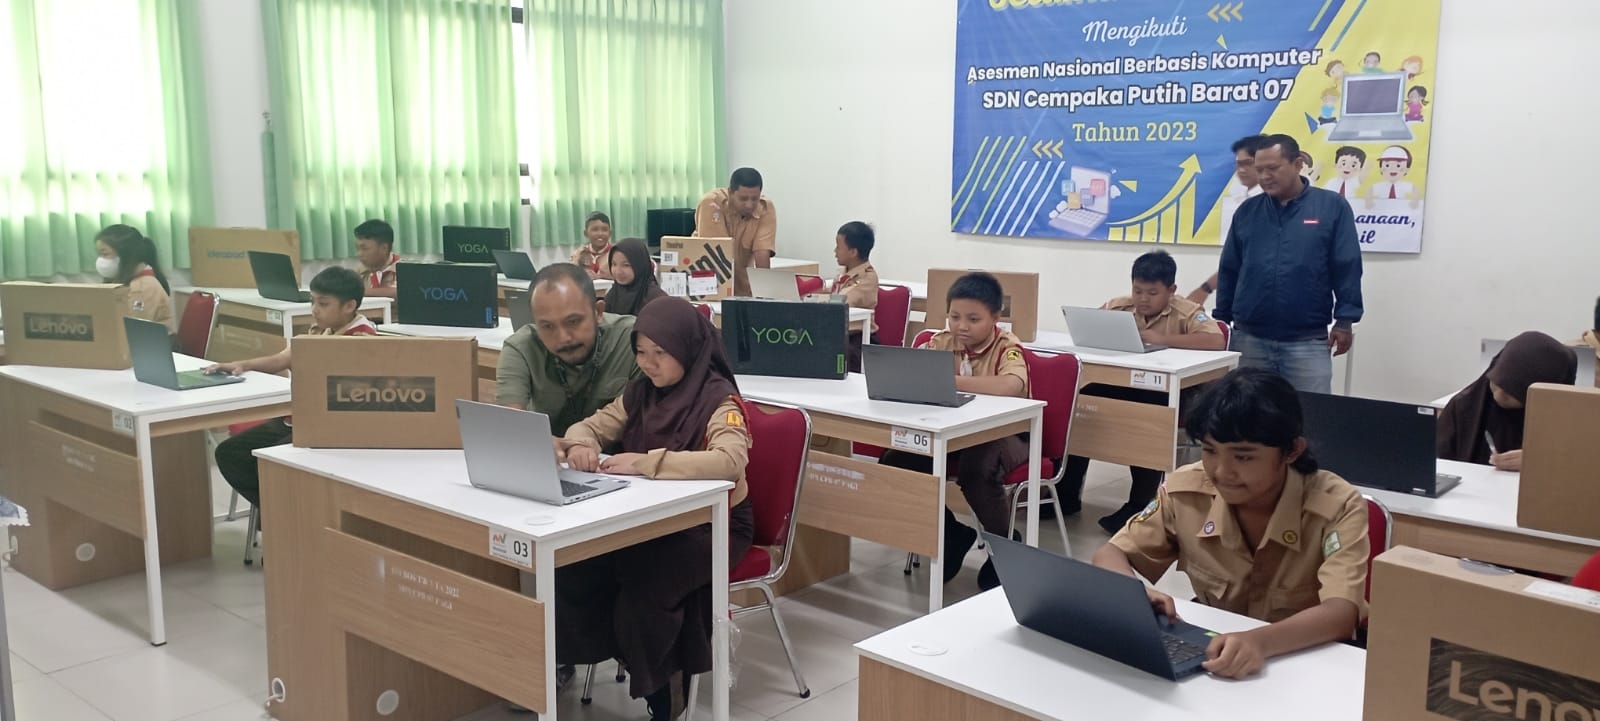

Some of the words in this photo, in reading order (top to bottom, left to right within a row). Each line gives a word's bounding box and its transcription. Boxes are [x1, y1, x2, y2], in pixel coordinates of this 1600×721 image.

[1082, 16, 1188, 47] Mengikuti
[967, 65, 1039, 82] Asesmen
[1043, 58, 1120, 78] Nasional
[1123, 52, 1208, 74] Berbasis
[1211, 48, 1322, 73] Komputer
[982, 90, 1021, 109] SDN
[1023, 86, 1124, 113] Cempaka
[1127, 82, 1186, 104] Putih
[1191, 79, 1258, 102] Barat
[1263, 78, 1294, 101] 07
[1072, 122, 1140, 142] Tahun
[1145, 121, 1198, 142] 2023
[1355, 214, 1416, 228] anaan,
[1359, 230, 1376, 244] il
[457, 243, 489, 254] YOGA
[419, 286, 468, 301] YOGA
[30, 317, 88, 335] Lenovo
[751, 326, 814, 346] YOGA
[336, 382, 426, 403] Lenovo
[913, 433, 928, 447] 06
[513, 540, 529, 558] 03
[1450, 659, 1600, 721] Leno
